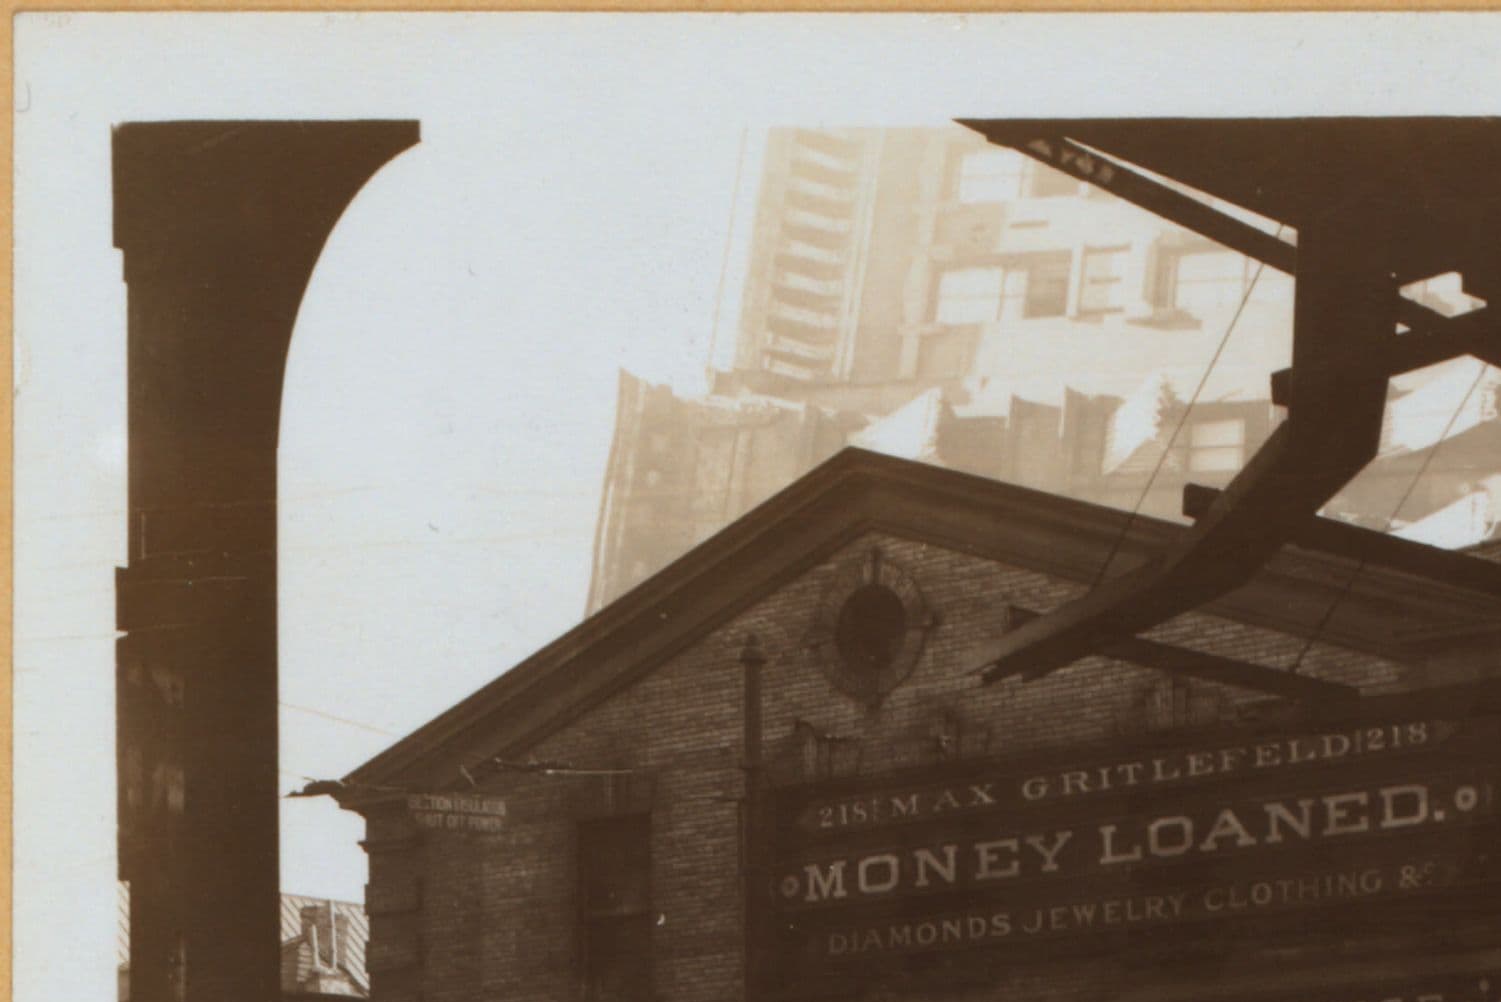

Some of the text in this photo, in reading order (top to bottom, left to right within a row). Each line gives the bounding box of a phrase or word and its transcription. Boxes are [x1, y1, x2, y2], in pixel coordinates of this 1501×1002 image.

[891, 783, 998, 817] MAX
[1021, 734, 1351, 801] GRITLEFELD
[803, 830, 1074, 902] MONEY
[828, 911, 1012, 956] DIAMONDS
[1023, 893, 1185, 934] JEWELRY
[1203, 869, 1383, 912] CLOTHING
